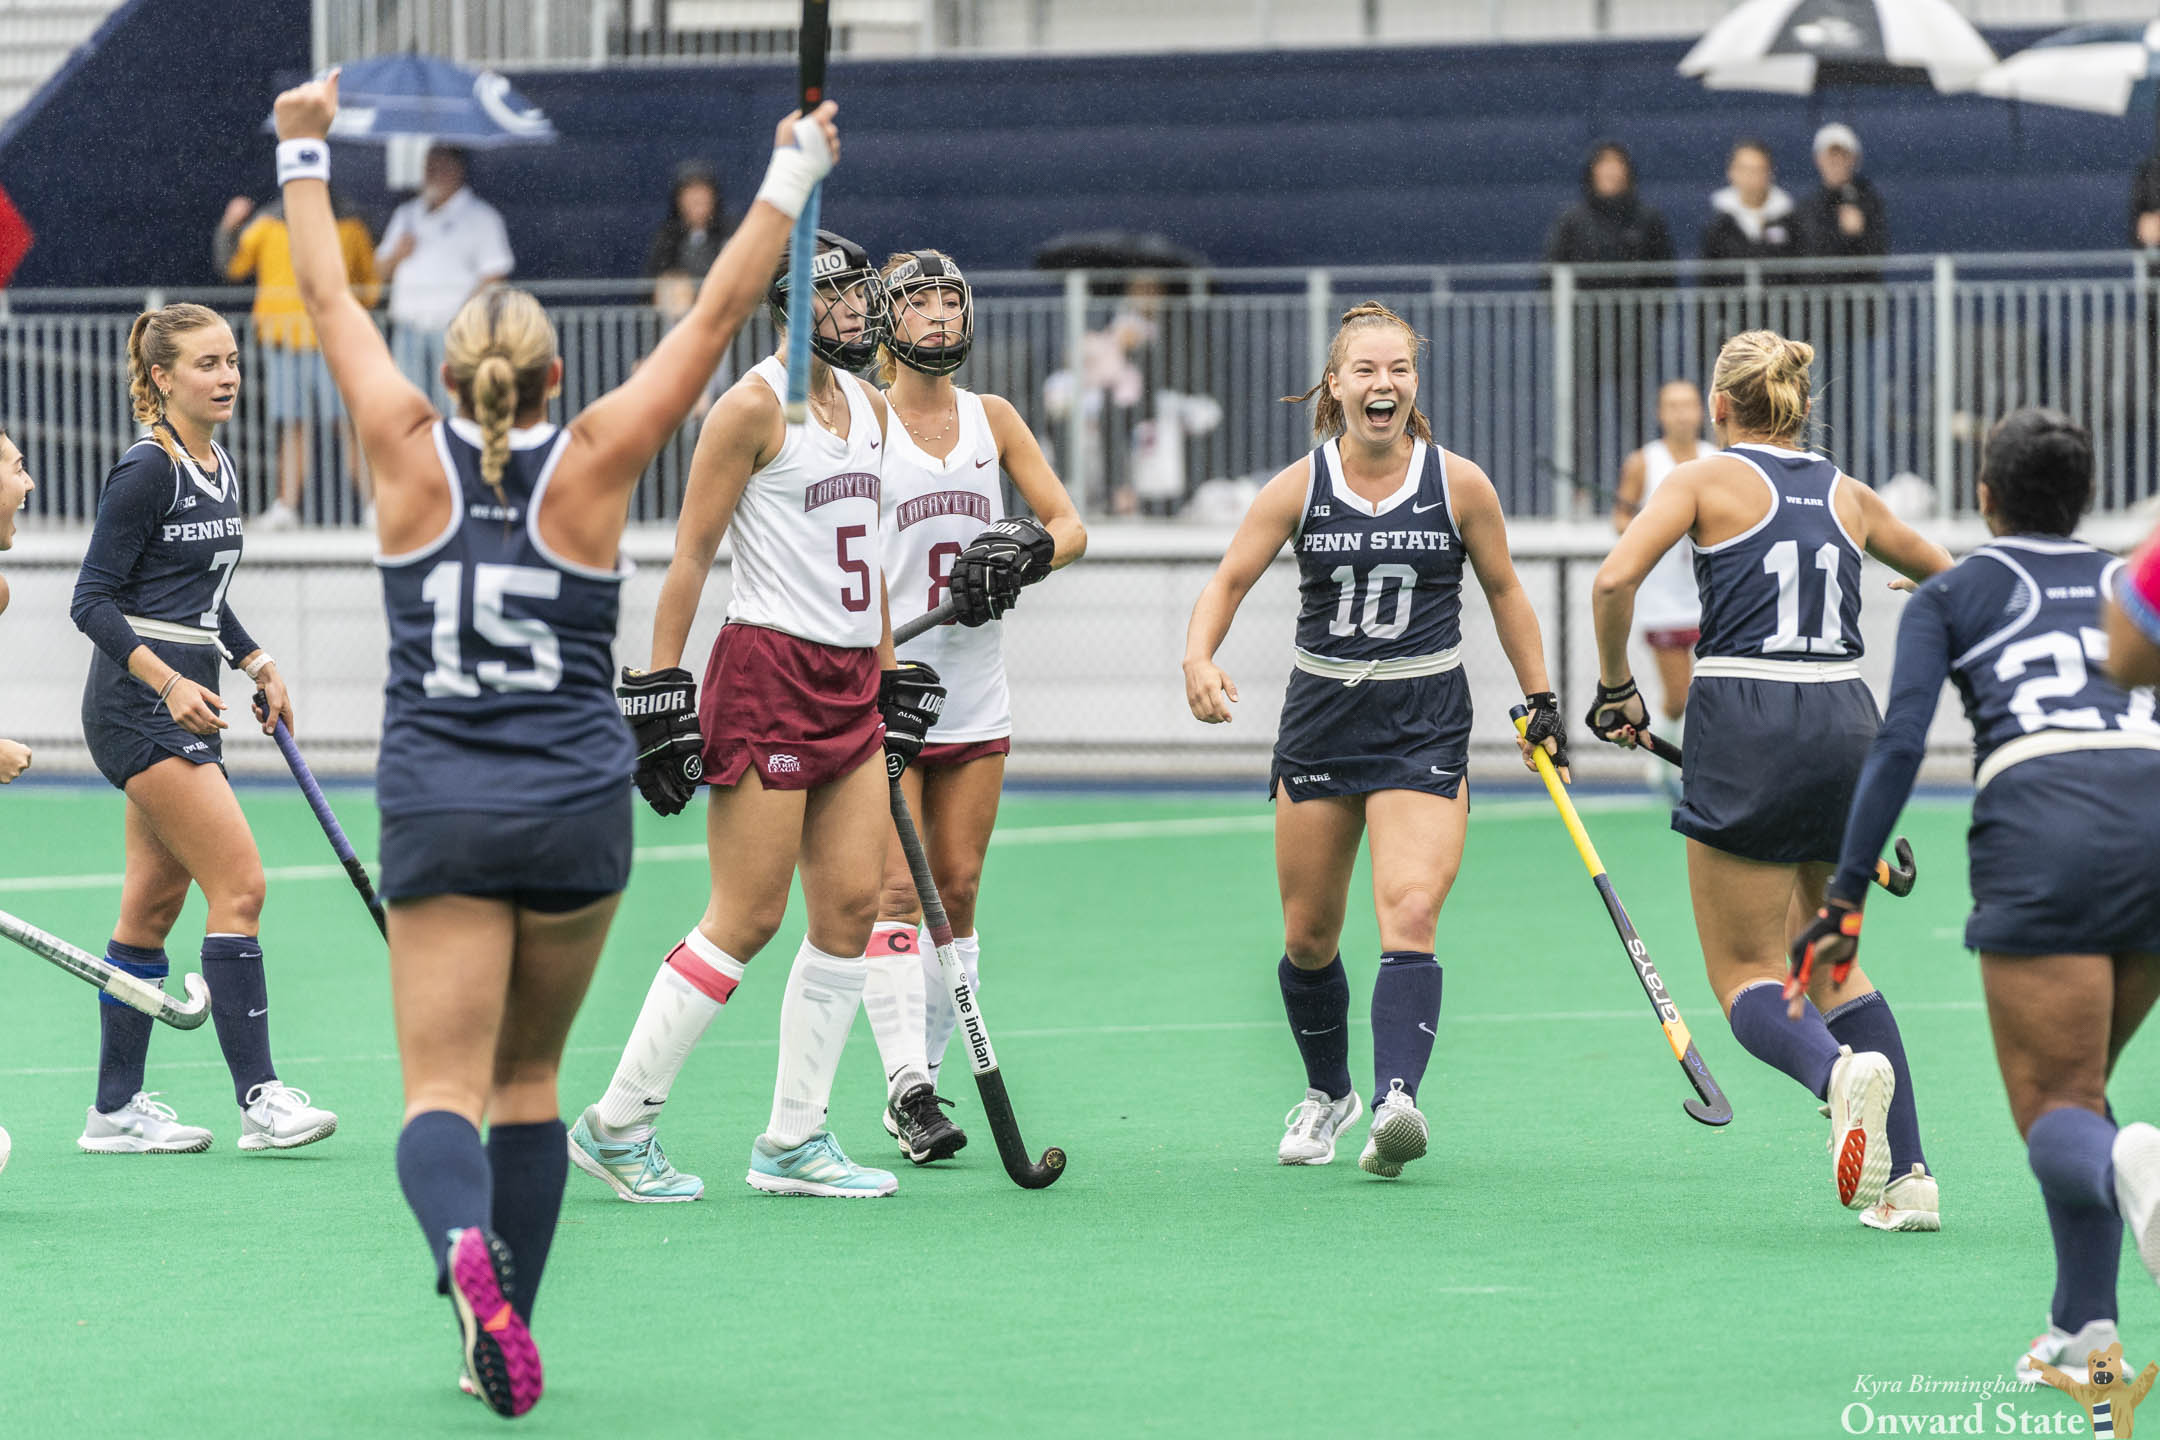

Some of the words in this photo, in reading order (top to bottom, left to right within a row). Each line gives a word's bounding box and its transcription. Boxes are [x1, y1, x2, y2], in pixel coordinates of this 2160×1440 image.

[812, 253, 842, 274] LLO
[805, 473, 880, 513] LAFAYETT
[897, 490, 990, 532] LAFAYETTE
[1785, 496, 1803, 504] WE
[1803, 498, 1824, 506] ARE
[162, 519, 224, 542] PENN
[226, 517, 243, 536] ST
[1303, 532, 1363, 551] PENN
[1370, 531, 1450, 551] STATE
[836, 524, 871, 612] 5
[928, 541, 964, 625] 8
[200, 549, 240, 628] 7
[1329, 563, 1418, 640] 10
[1762, 540, 1848, 654] 11
[421, 560, 563, 698] 15
[618, 690, 687, 716] RRIOR
[898, 711, 922, 724] ALPHA
[1292, 775, 1309, 785] WE
[1309, 772, 1331, 782] ARE
[887, 931, 912, 953] C
[955, 983, 973, 1014] the
[964, 1015, 991, 1069] indian
